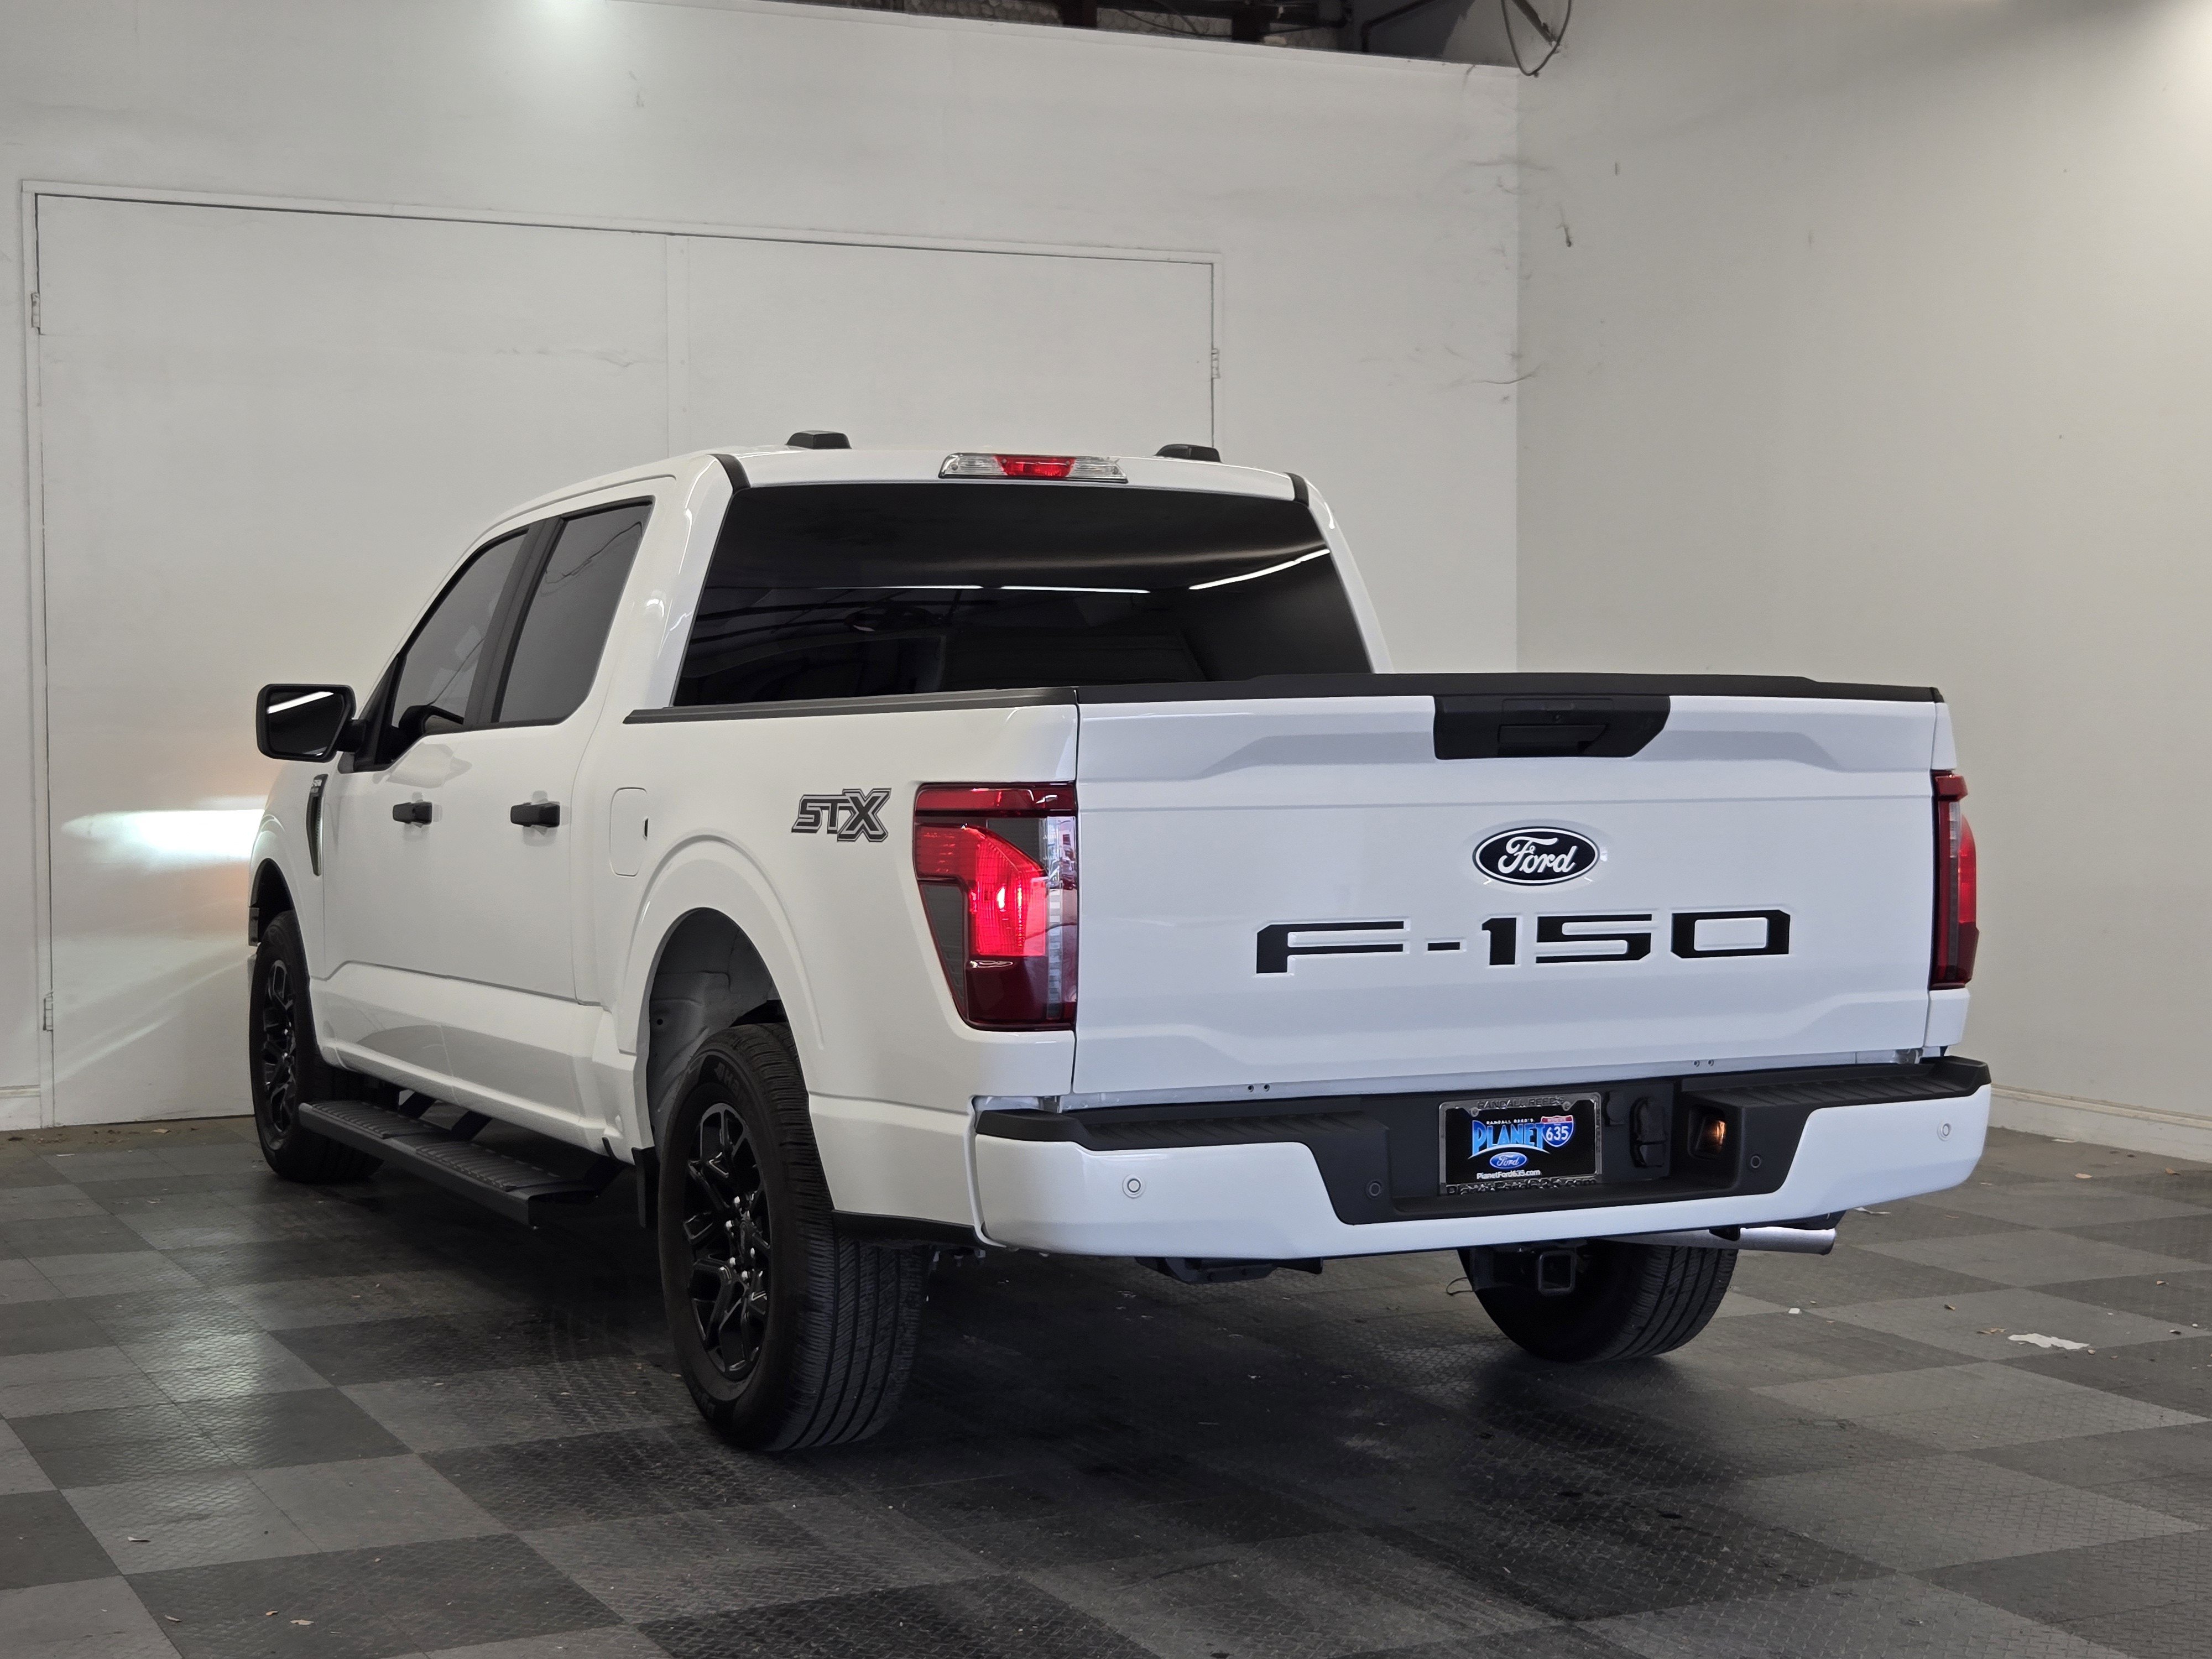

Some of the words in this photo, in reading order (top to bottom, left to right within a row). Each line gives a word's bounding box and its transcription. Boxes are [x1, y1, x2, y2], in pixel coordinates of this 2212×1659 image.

[791, 787, 892, 842] STX
[1497, 836, 1578, 874] Ford
[1255, 909, 1791, 974] F-150
[1472, 1120, 1547, 1155] PLANET
[1546, 1125, 1569, 1141] 635
[1496, 1155, 1520, 1167] Ford
